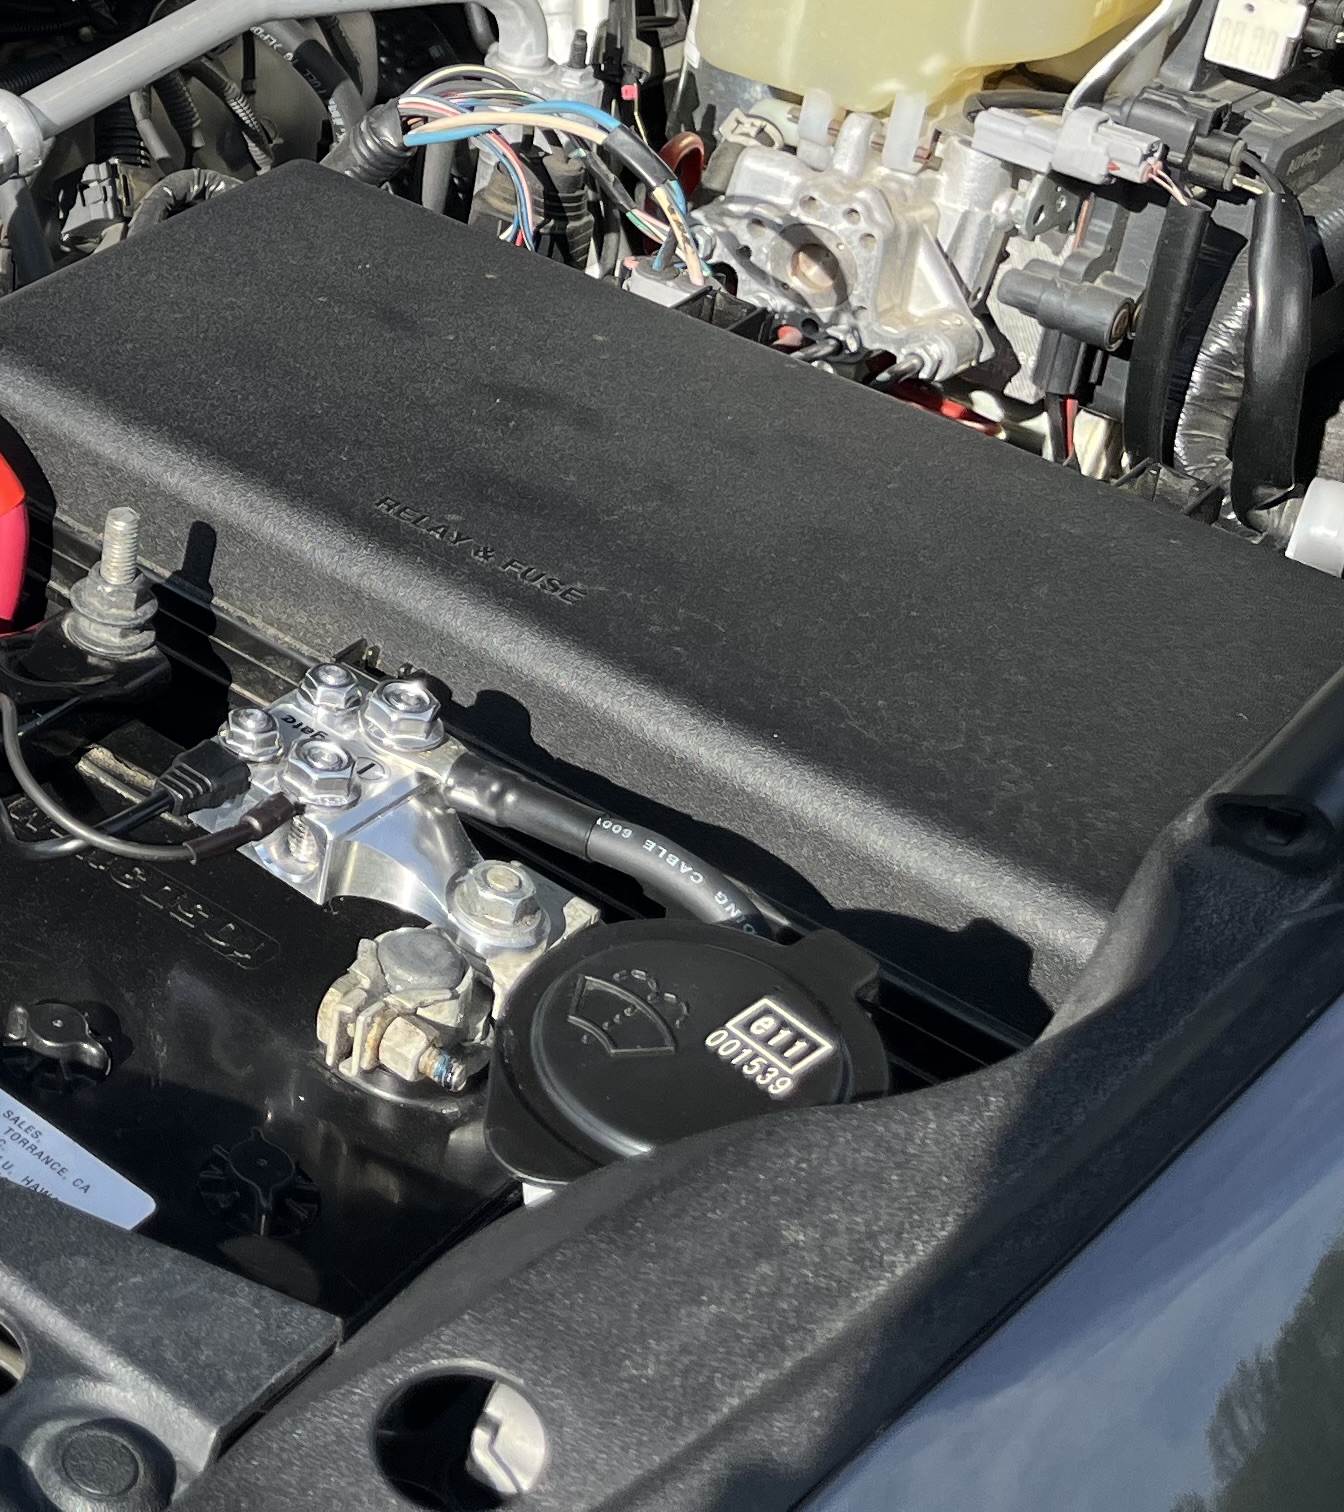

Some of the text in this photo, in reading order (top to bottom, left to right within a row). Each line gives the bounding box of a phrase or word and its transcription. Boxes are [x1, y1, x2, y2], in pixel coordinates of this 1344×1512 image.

[374, 496, 474, 546] RELAY
[499, 558, 588, 605] FUSE
[643, 839, 704, 884] CABLE
[750, 1016, 808, 1058] e11
[705, 1030, 793, 1094] 001539
[69, 1176, 93, 1193] CA
